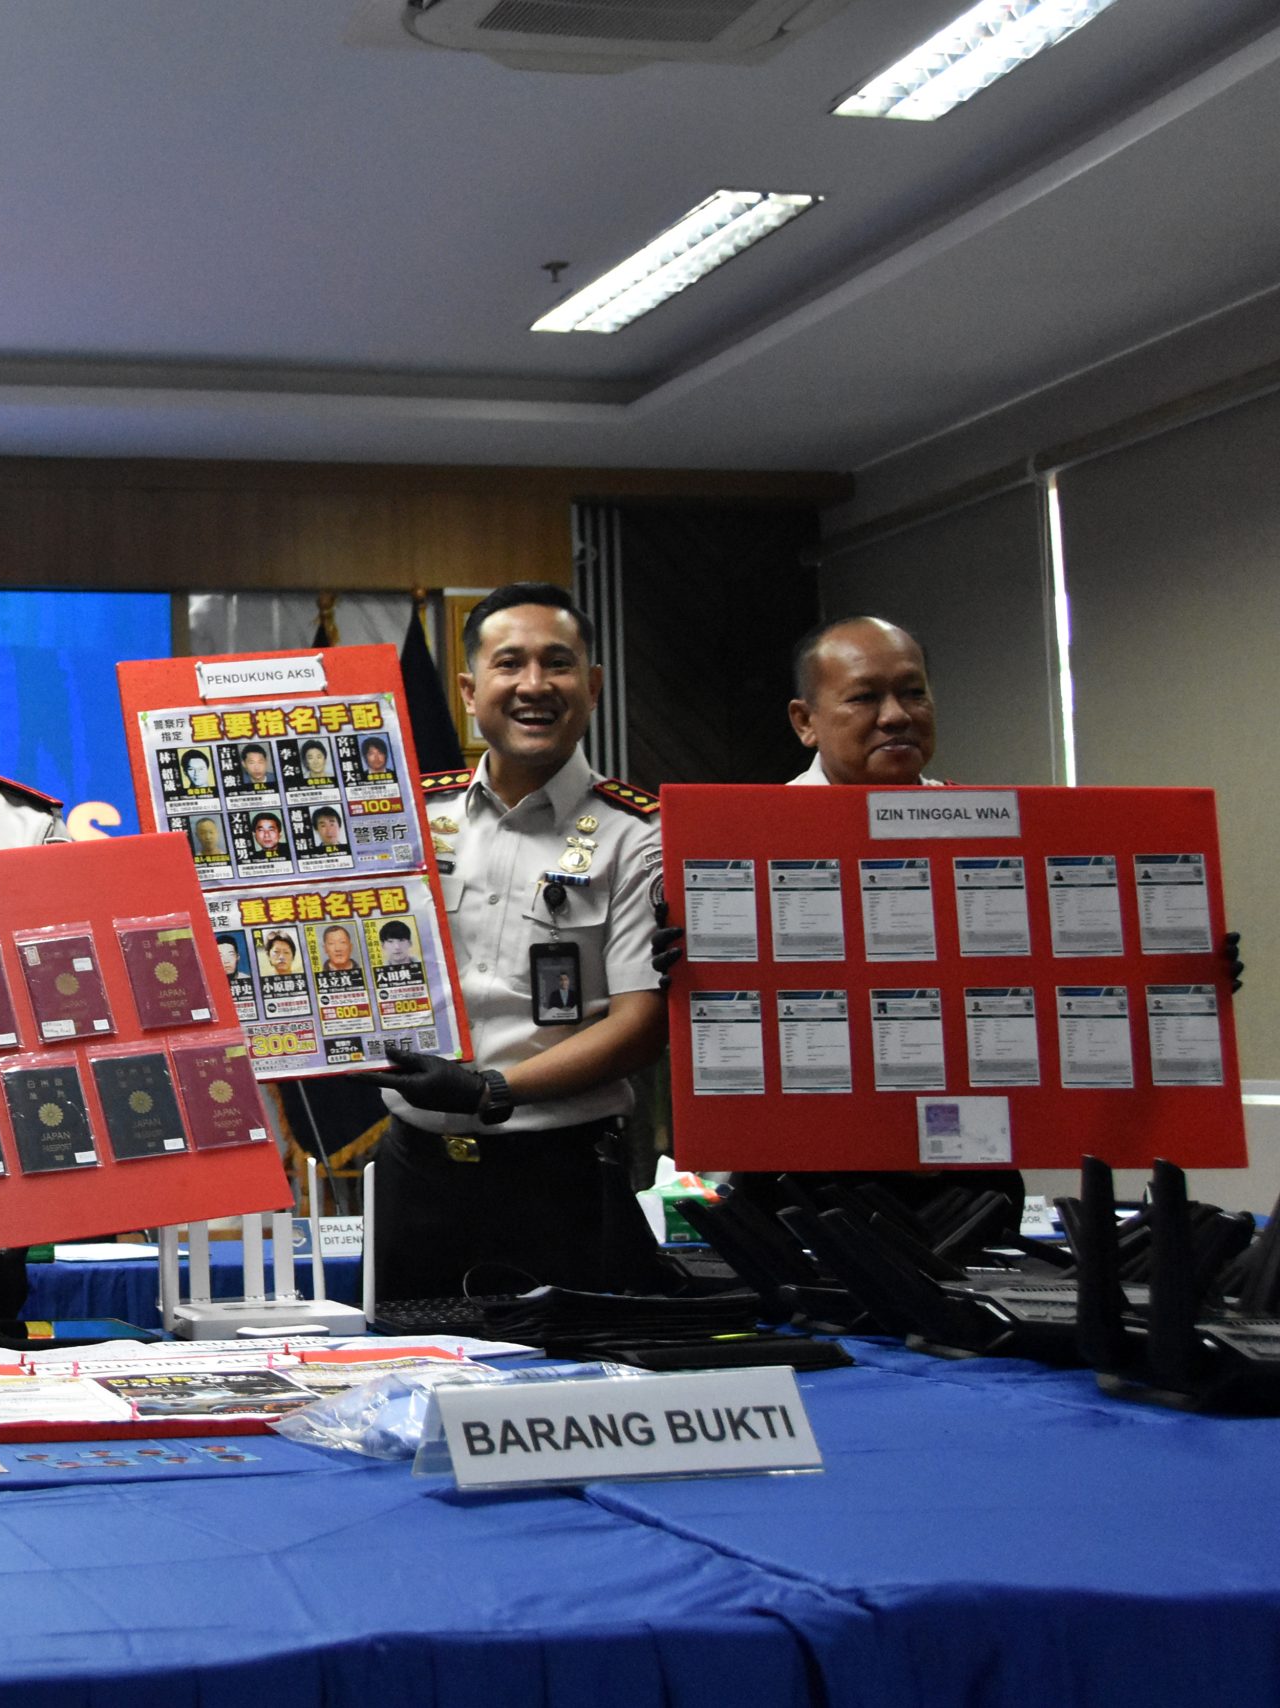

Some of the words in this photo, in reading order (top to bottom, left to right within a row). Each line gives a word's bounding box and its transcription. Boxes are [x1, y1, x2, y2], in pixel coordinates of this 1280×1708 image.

[207, 670, 284, 685] PENDUKUNG
[287, 668, 316, 681] AKSI
[153, 717, 186, 731] 警察庁
[189, 701, 383, 743] 重要指名手配
[161, 731, 183, 742] 指定
[876, 808, 904, 821] IZIN
[907, 807, 971, 821] TINGGAL
[976, 806, 1011, 821] WNA
[352, 823, 409, 844] 警察庁
[238, 886, 409, 926] 重要指名手配
[212, 1108, 241, 1119] JAPAN
[40, 1130, 72, 1142] JAPAN
[461, 1411, 656, 1457] BARANG
[664, 1404, 796, 1445] BUKTI
